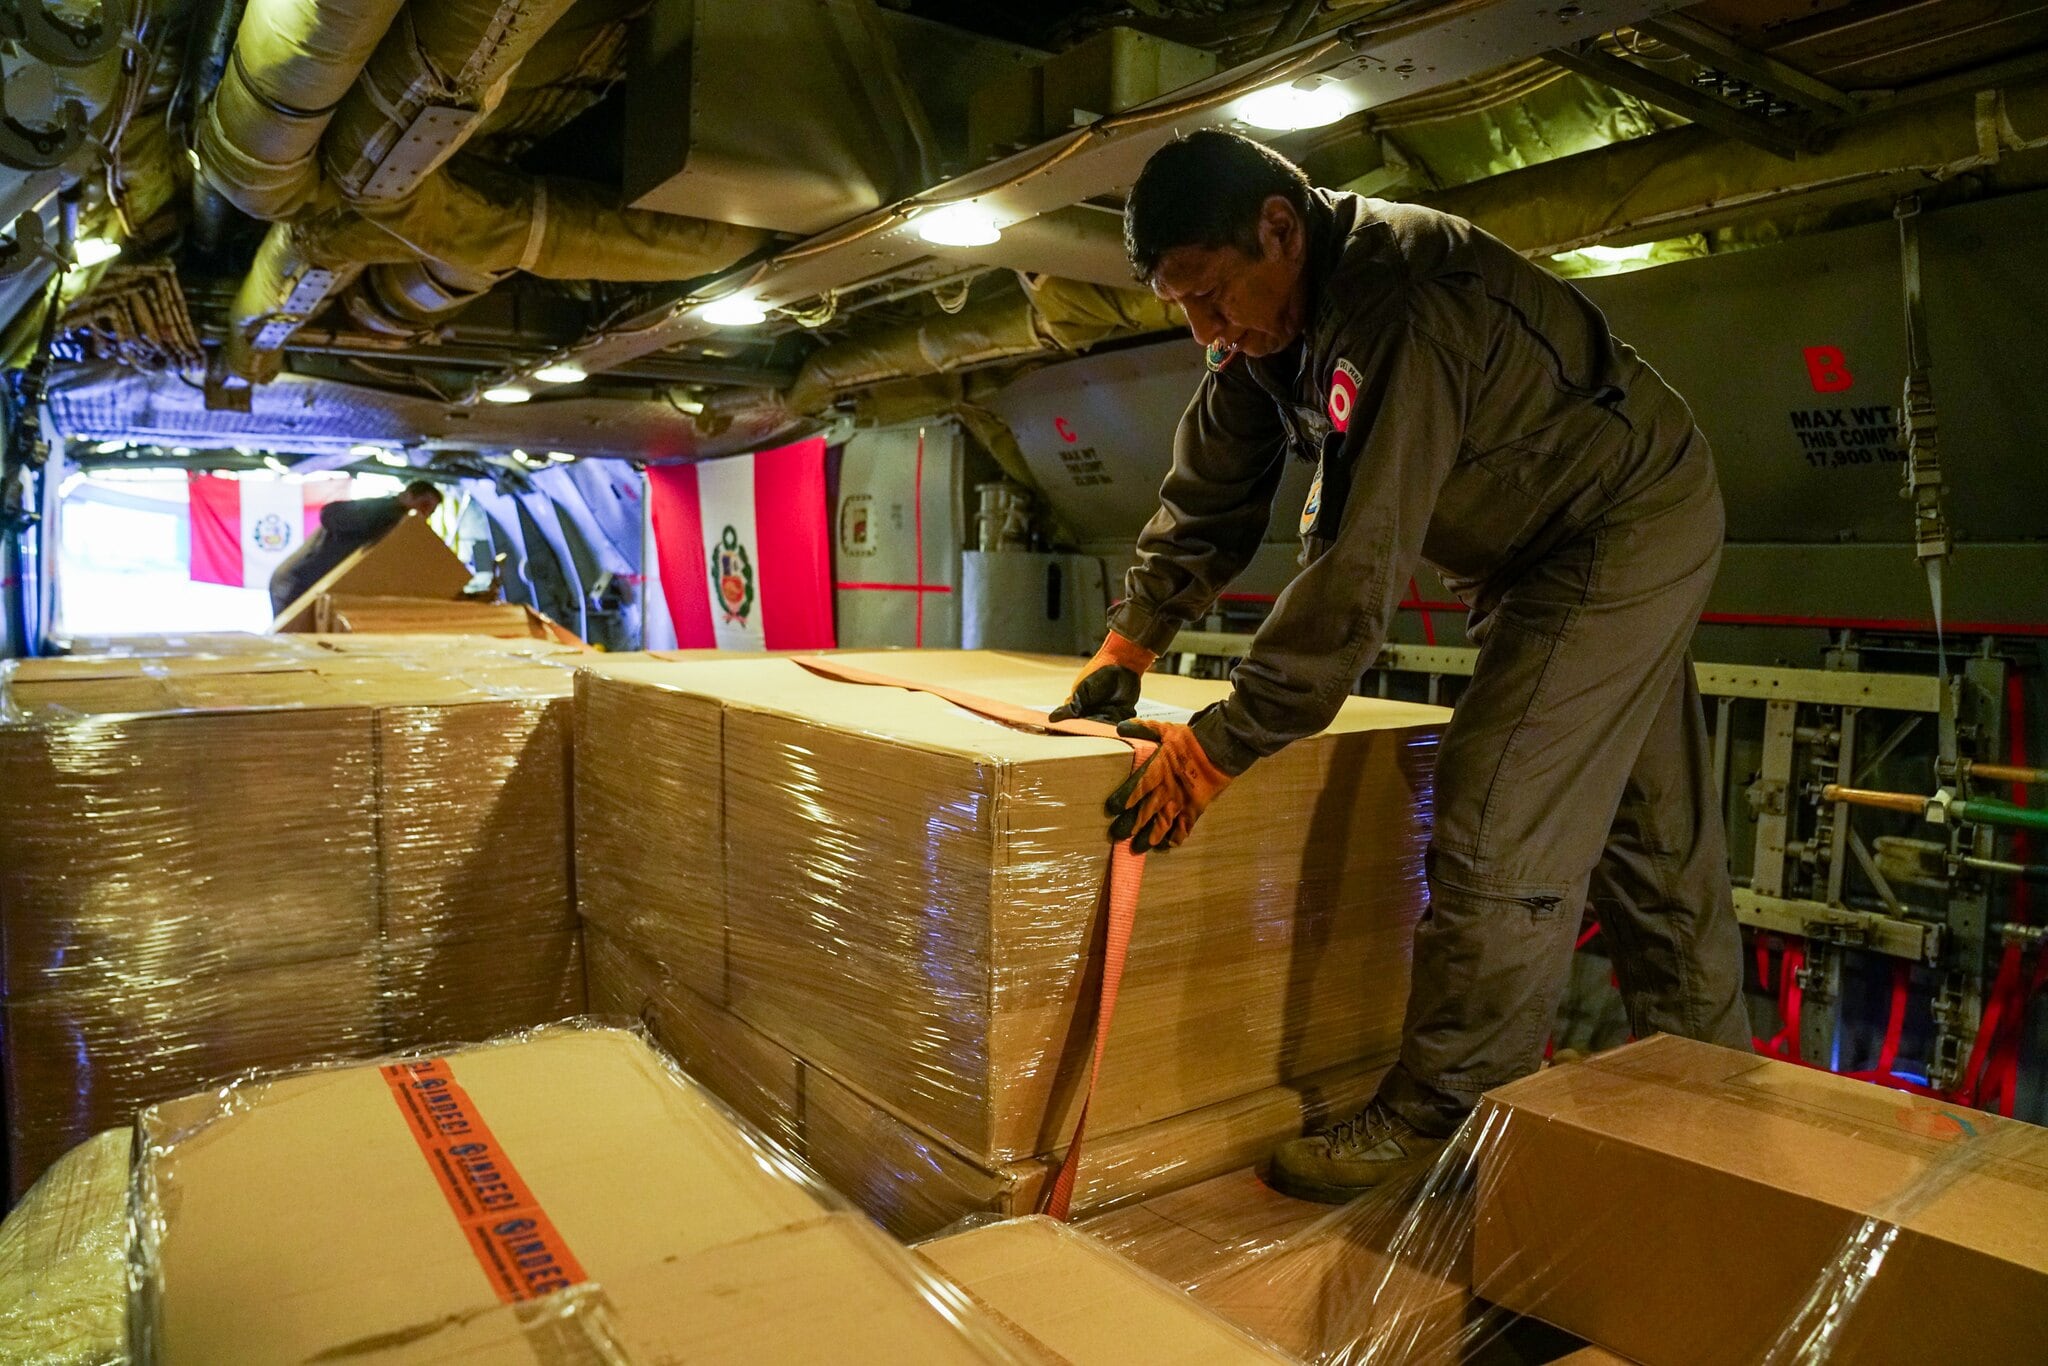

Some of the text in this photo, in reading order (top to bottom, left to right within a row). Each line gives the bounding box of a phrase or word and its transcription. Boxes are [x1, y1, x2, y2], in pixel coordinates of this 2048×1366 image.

[1803, 345, 1853, 393] B
[1790, 406, 1891, 428] MAX WT
[1055, 416, 1077, 443] C
[1797, 427, 1898, 448] THIS COMPT
